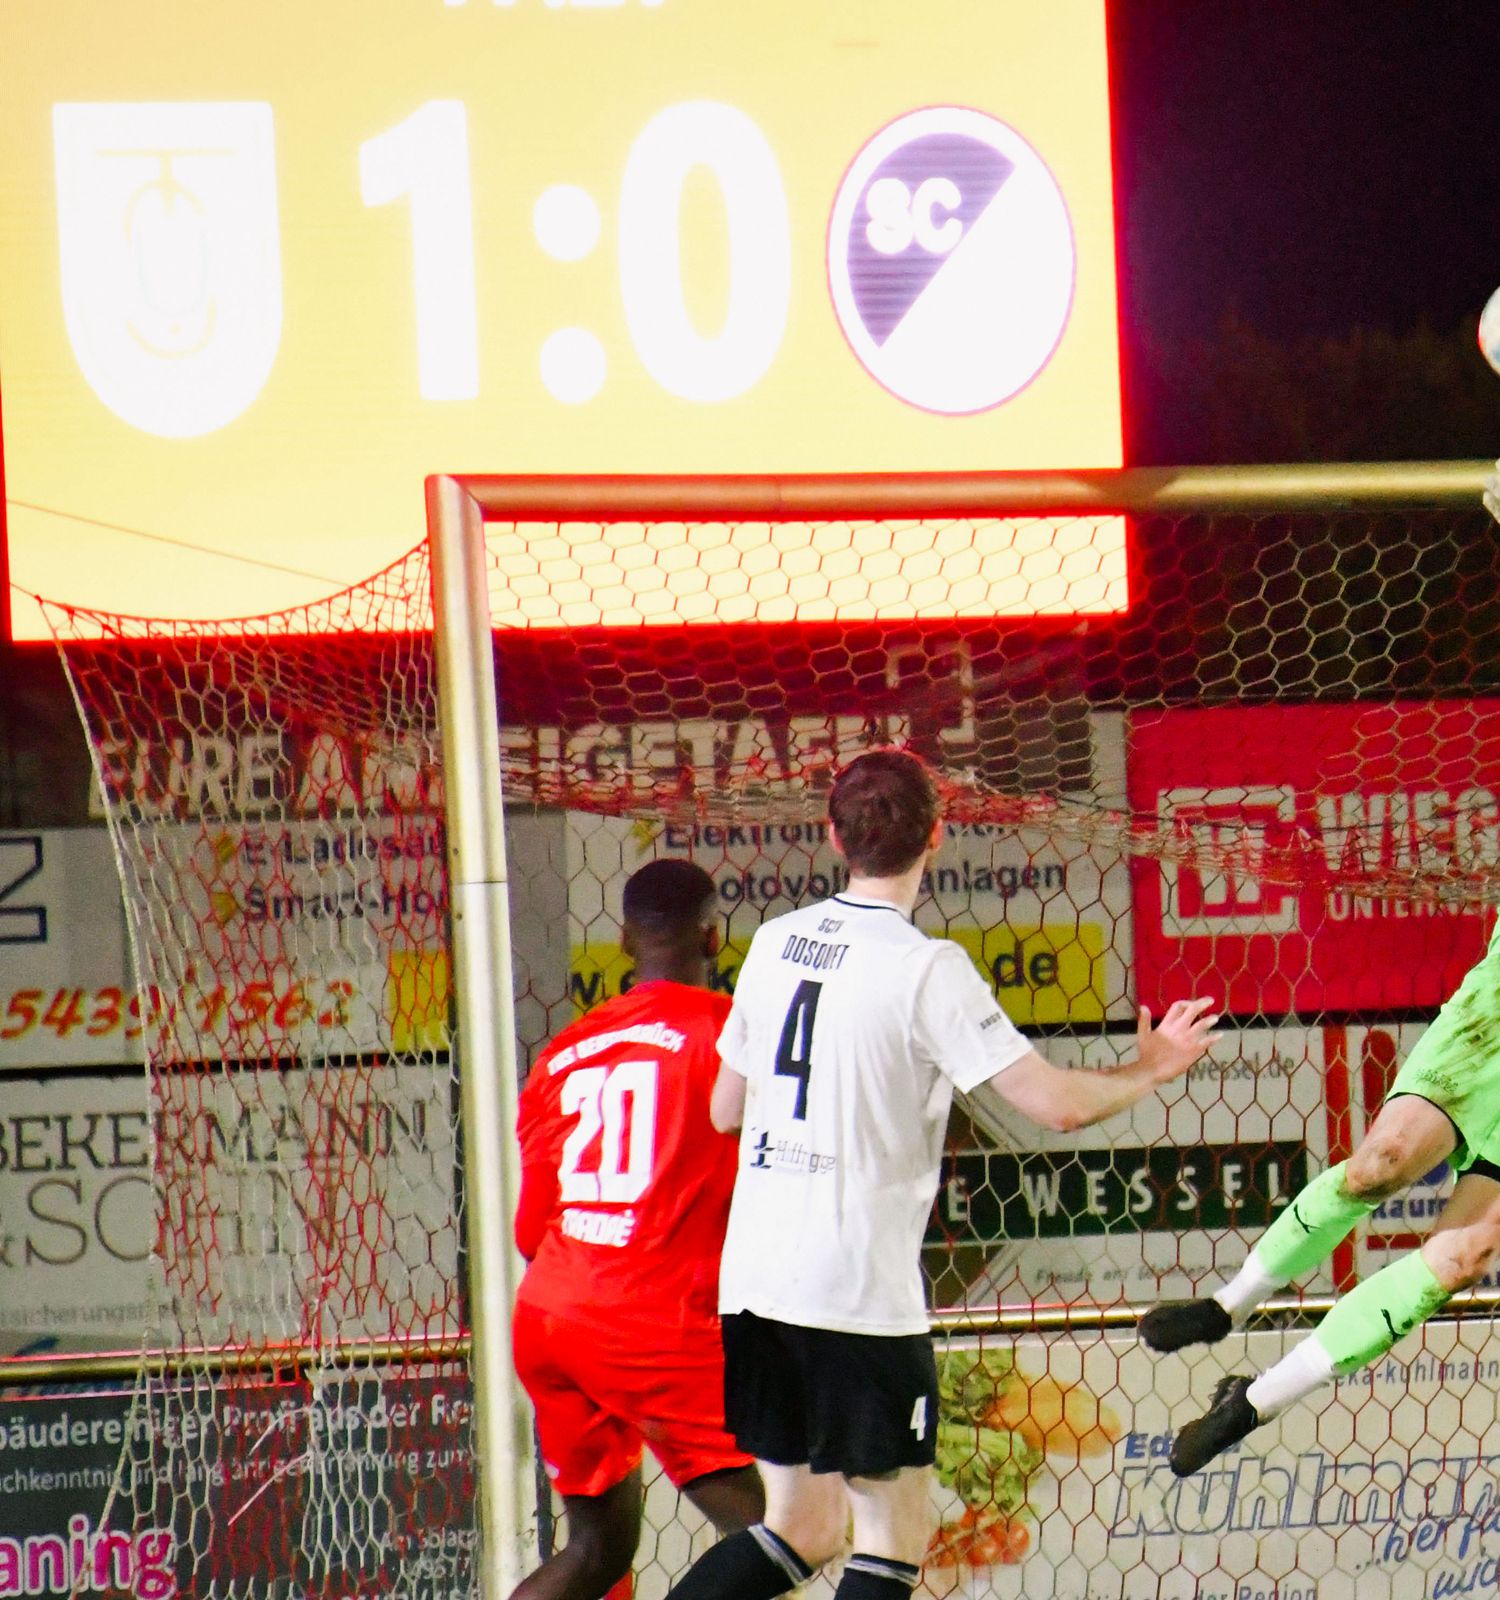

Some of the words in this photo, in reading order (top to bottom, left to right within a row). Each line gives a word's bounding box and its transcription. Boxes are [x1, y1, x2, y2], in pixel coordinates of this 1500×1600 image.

[358, 98, 793, 404] 1:0
[865, 177, 963, 255] SC
[774, 979, 823, 1121] 4
[557, 1060, 660, 1204] 20
[1022, 1160, 1290, 1219] WESSEL
[909, 1395, 928, 1442] 4
[0, 1463, 124, 1494] chkenntnis
